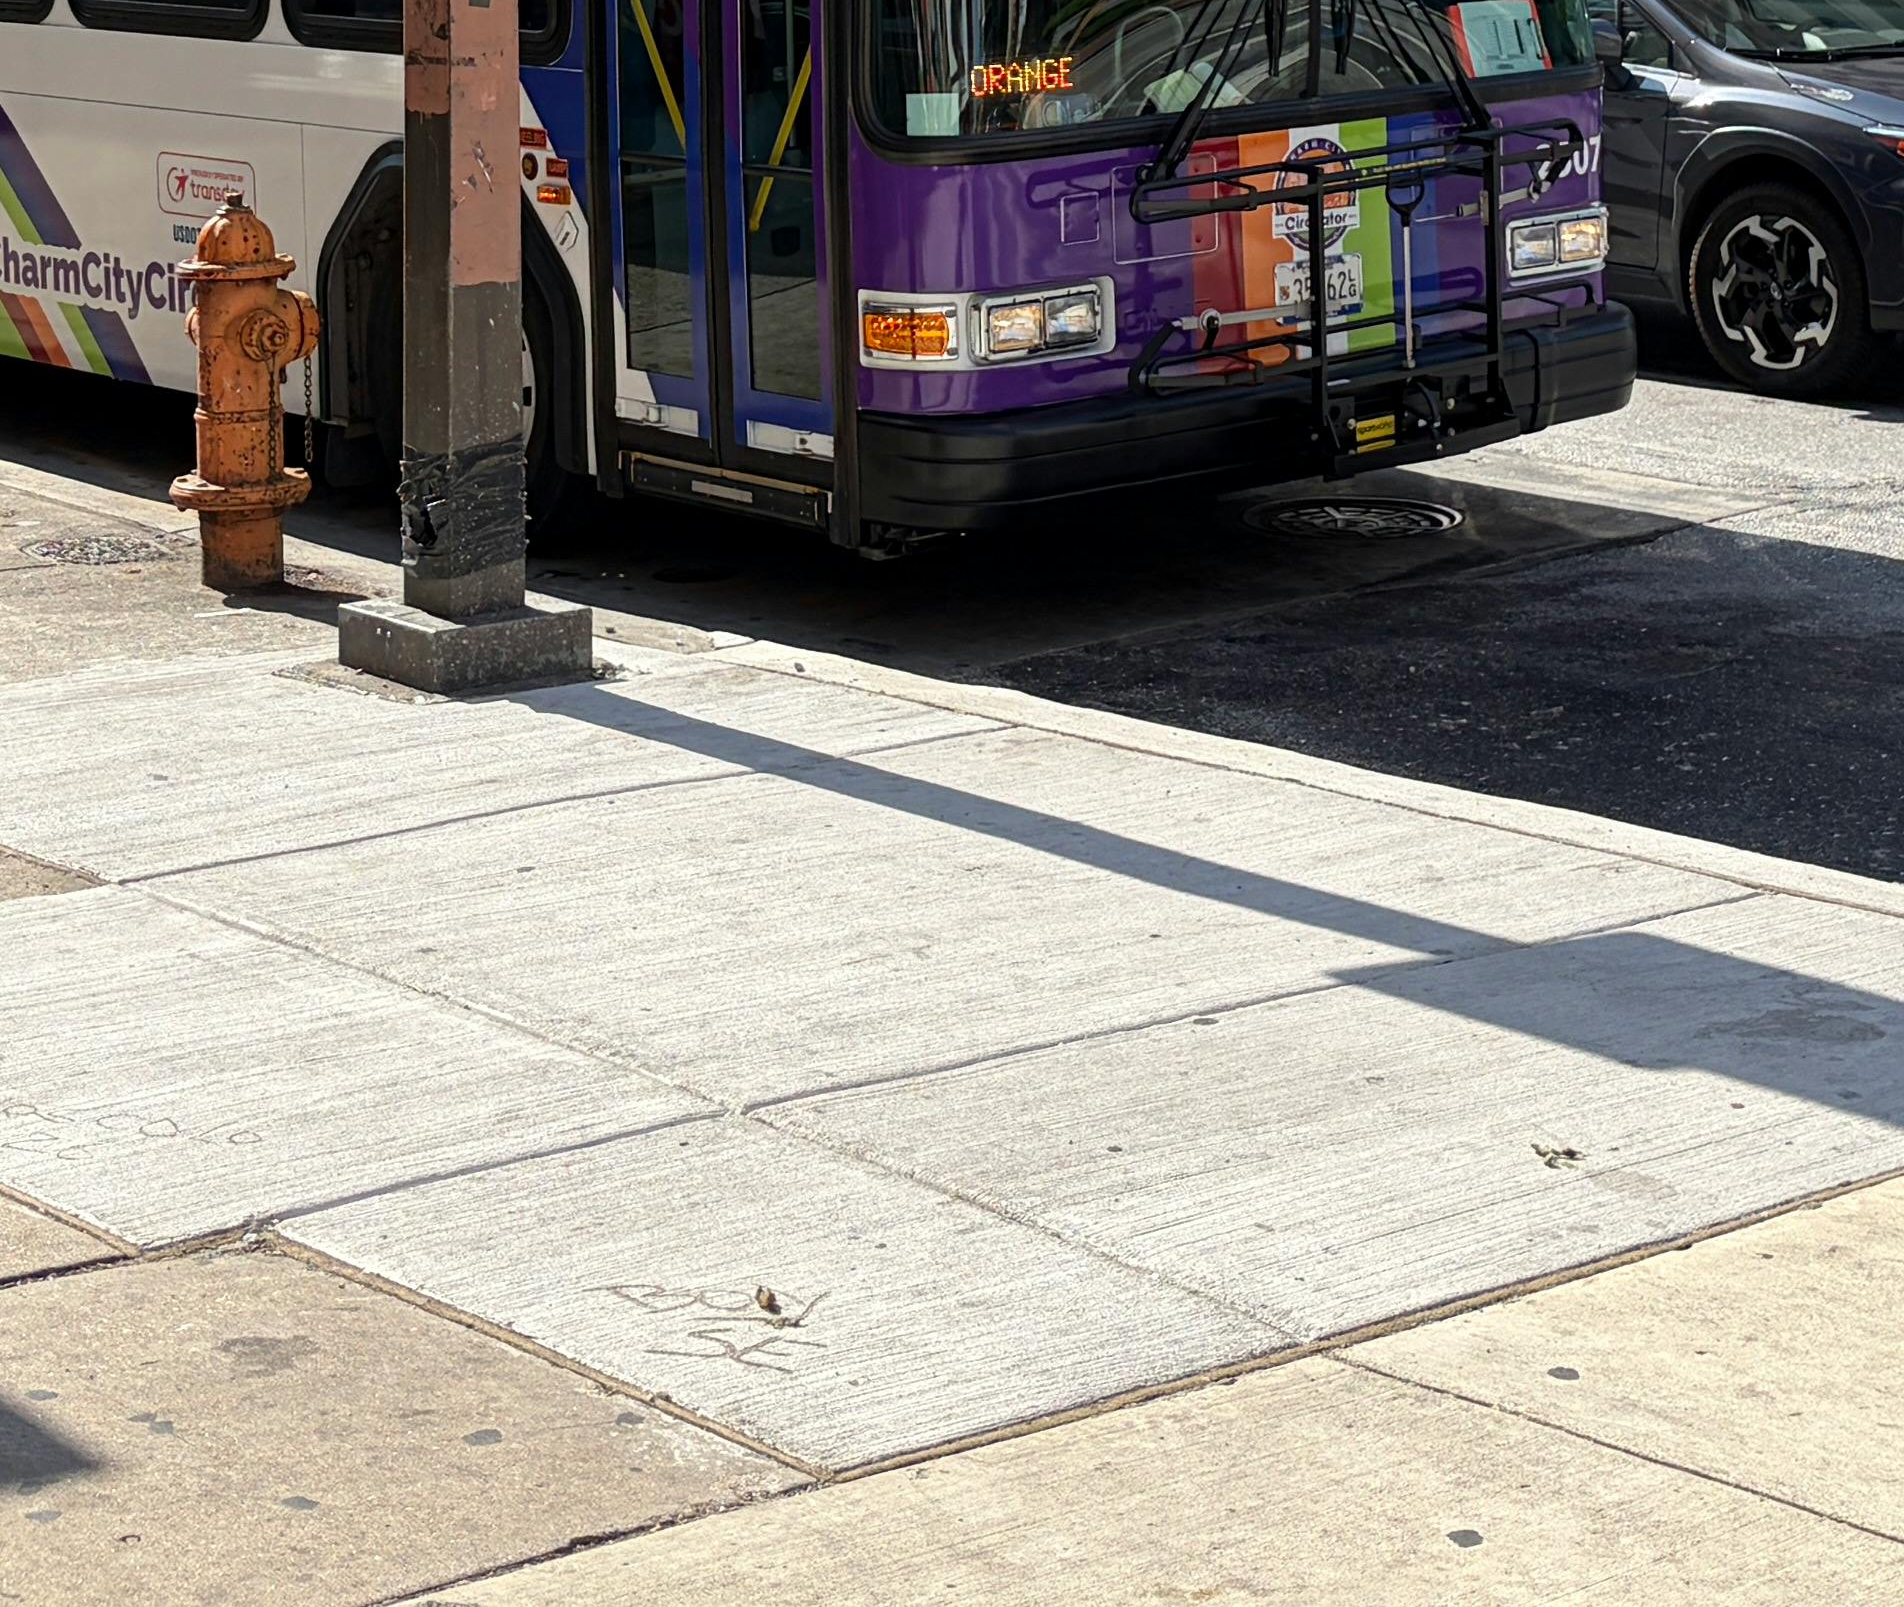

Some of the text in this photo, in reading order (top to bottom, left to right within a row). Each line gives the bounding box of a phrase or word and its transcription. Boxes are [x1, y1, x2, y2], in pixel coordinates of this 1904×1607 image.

[971, 57, 1073, 96] ORANGE
[190, 178, 245, 203] transd
[1285, 211, 1348, 232] Circator
[1293, 270, 1348, 304] 362
